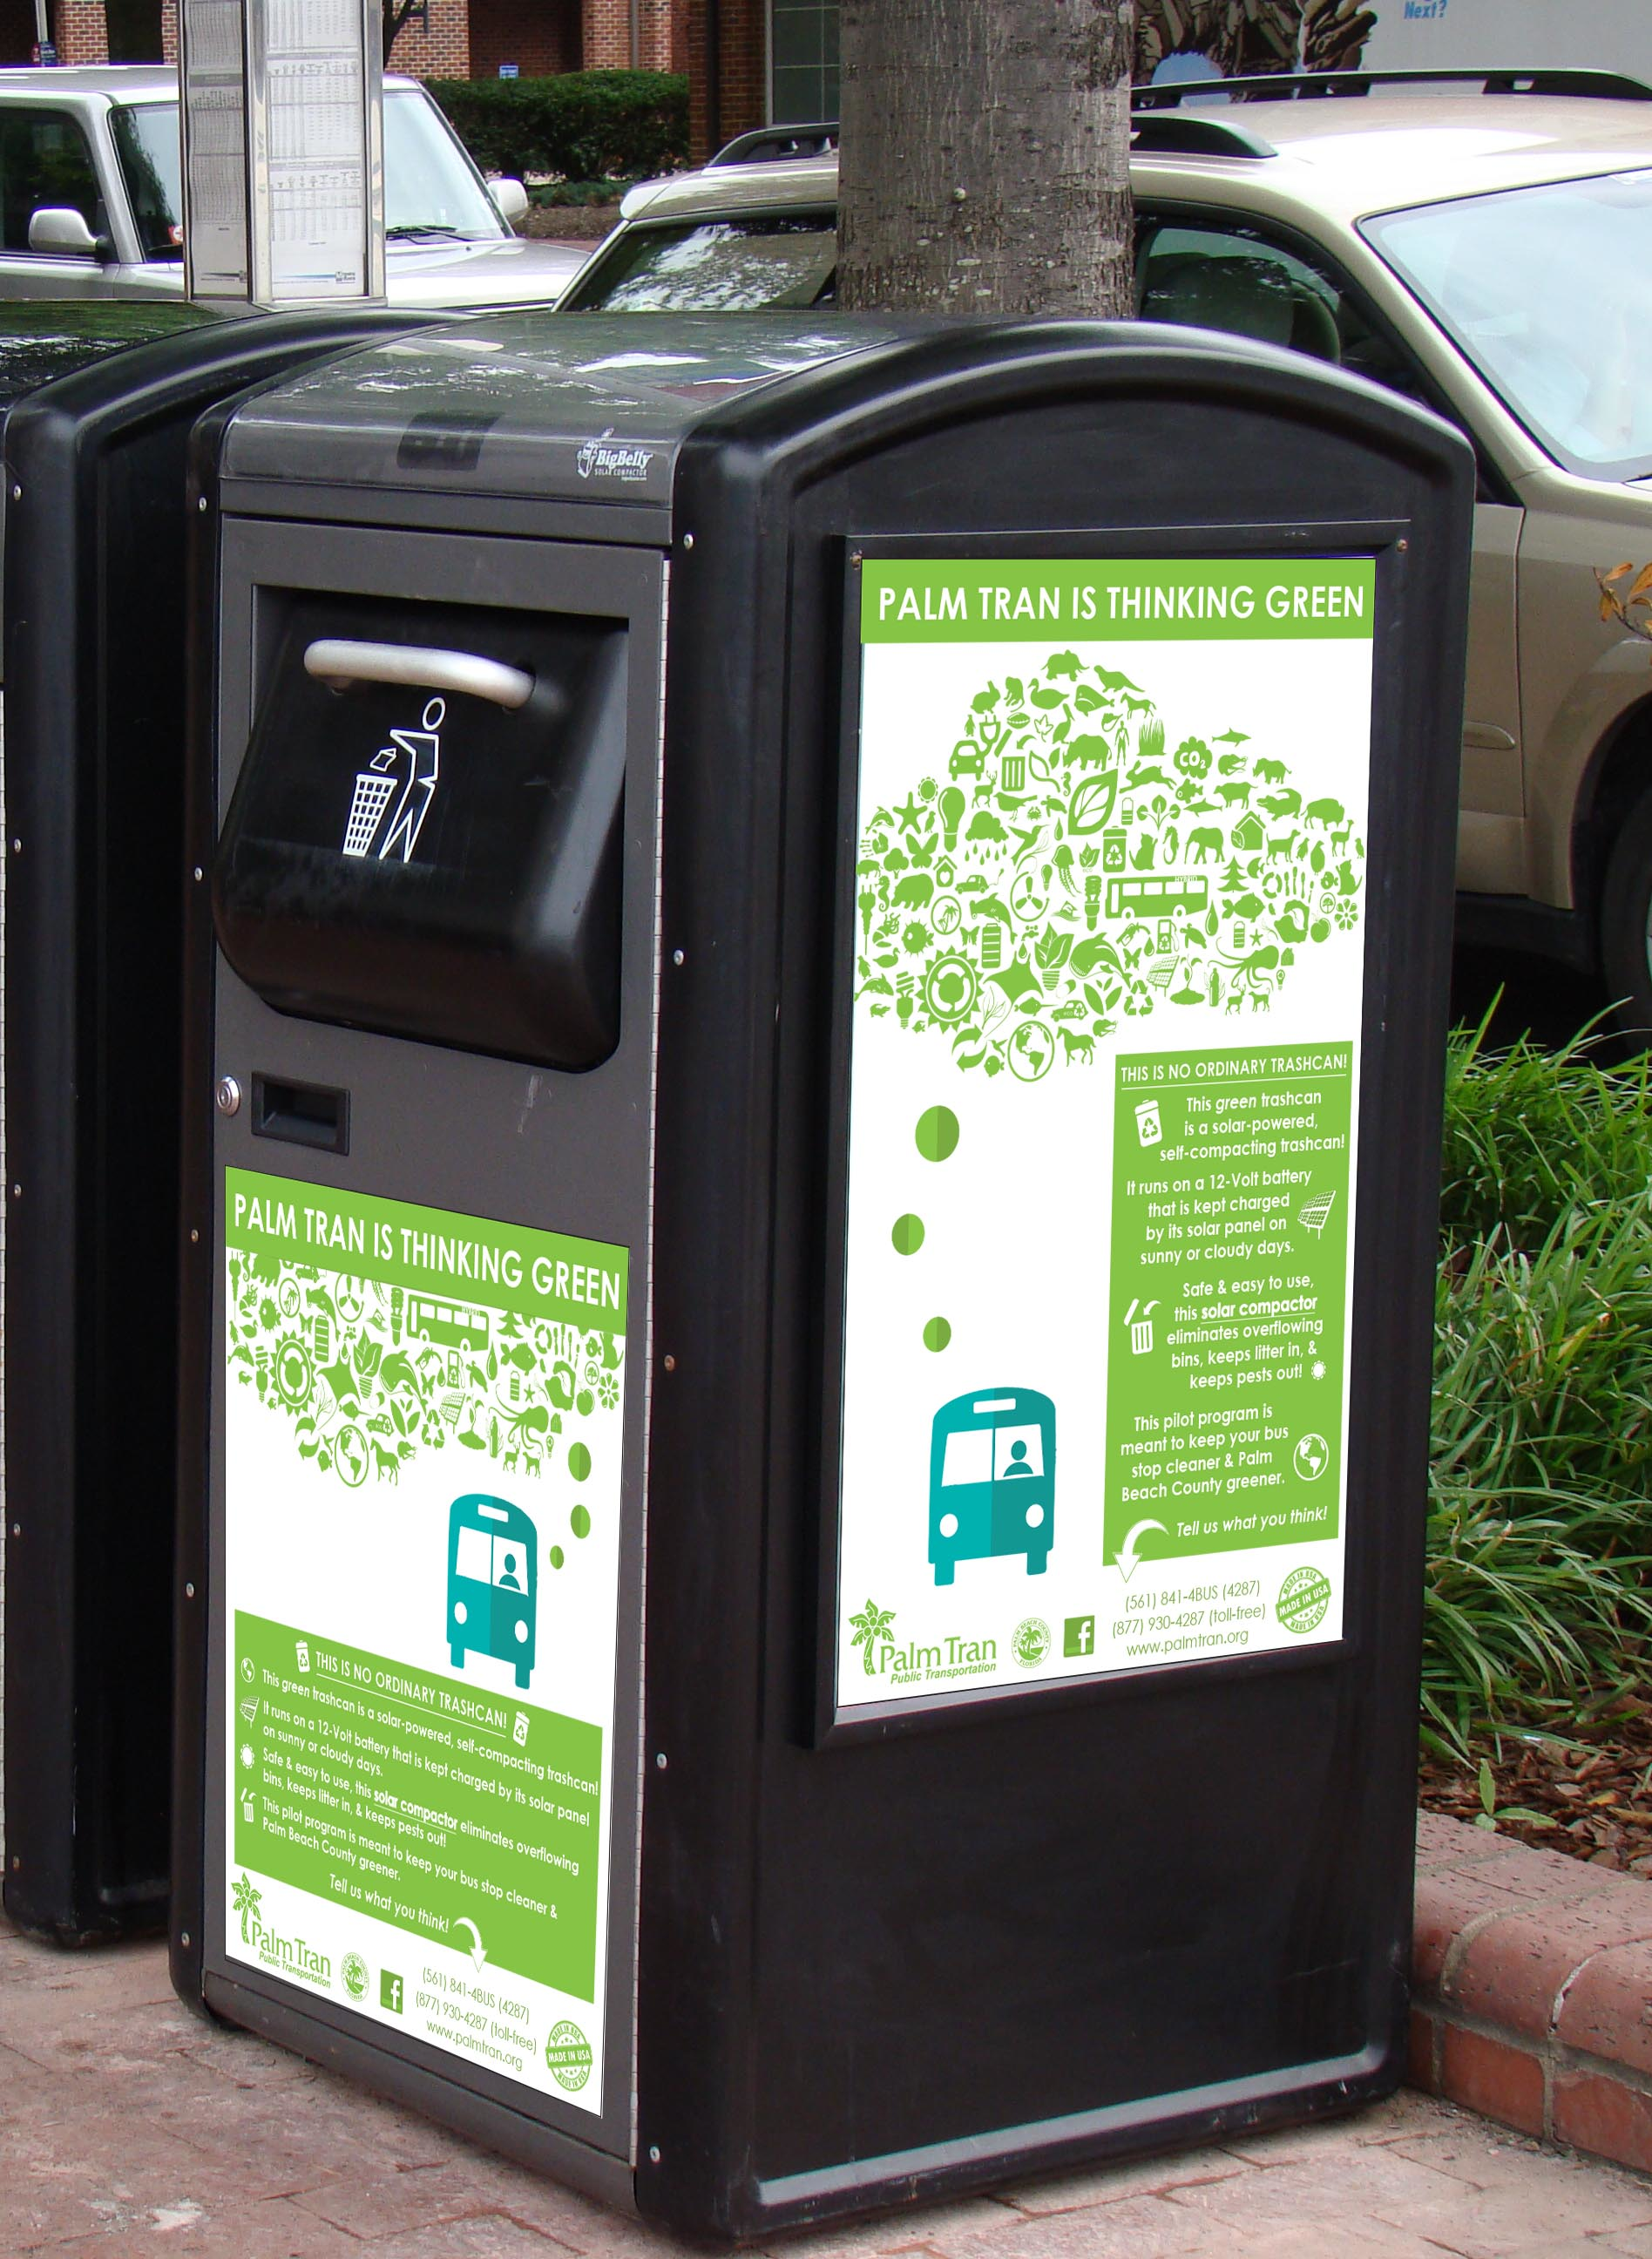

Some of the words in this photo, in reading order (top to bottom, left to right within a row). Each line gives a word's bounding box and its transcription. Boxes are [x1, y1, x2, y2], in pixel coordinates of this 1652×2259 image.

[1403, 0, 1448, 19] Next?
[595, 449, 653, 470] BigBelly
[879, 587, 968, 621] PALM
[978, 587, 1060, 620] TRAN
[1072, 586, 1097, 621] IS
[1106, 585, 1256, 619] THINKING
[1265, 585, 1364, 619] GREEN
[1121, 1066, 1148, 1082] THIS
[1153, 1065, 1164, 1081] IS
[1168, 1062, 1191, 1080] NO
[1195, 1058, 1267, 1078] ORDINARY
[1270, 1054, 1347, 1073] TRASHCAN!
[1186, 1096, 1212, 1112] This
[1215, 1096, 1257, 1115] green
[1261, 1090, 1322, 1108] trashcan
[1184, 1120, 1195, 1136] is
[1198, 1123, 1209, 1136] a
[1212, 1112, 1318, 1136] solar-powered,
[1160, 1139, 1276, 1162] self-compacting
[1280, 1133, 1344, 1153] trashcan!
[1127, 1180, 1136, 1196] It
[1139, 1181, 1168, 1195] runs
[1172, 1179, 1191, 1192] on
[1195, 1178, 1205, 1191] a
[1209, 1171, 1259, 1190] 12-Volt
[1263, 1169, 1312, 1186] battery
[1148, 1201, 1176, 1218] that
[1180, 1199, 1190, 1216] is
[1194, 1197, 1227, 1218] kept
[1229, 1191, 1290, 1213] charged
[1146, 1225, 1165, 1245] by
[1168, 1223, 1183, 1239] its
[1187, 1221, 1221, 1238] solar
[1224, 1217, 1265, 1238] panel
[1269, 1218, 1287, 1231] on
[234, 1192, 297, 1239] PALM
[303, 1207, 365, 1254] TRAN
[374, 1222, 393, 1261] IS
[400, 1227, 523, 1288] THINKING
[531, 1256, 620, 1310] GREEN
[1141, 1250, 1182, 1266] sunny
[1186, 1248, 1201, 1261] or
[1204, 1241, 1254, 1260] cloudy
[1257, 1239, 1294, 1258] days.
[1182, 1281, 1214, 1298] Safe
[1217, 1279, 1227, 1295] &
[1231, 1279, 1265, 1295] easy
[1269, 1275, 1283, 1290] to
[1287, 1275, 1314, 1288] use,
[1174, 1305, 1198, 1322] this
[1201, 1301, 1236, 1323] solar
[1238, 1294, 1318, 1317] compactor
[1167, 1325, 1239, 1346] eliminates
[1242, 1317, 1324, 1338] overflowing
[1171, 1352, 1203, 1368] bins,
[1208, 1349, 1251, 1367] keeps
[1255, 1344, 1284, 1360] litter
[1288, 1341, 1303, 1358] in,
[1308, 1340, 1317, 1355] &
[1189, 1374, 1233, 1390] keeps
[1236, 1367, 1273, 1388] pests
[1276, 1363, 1303, 1380] out!
[1134, 1414, 1160, 1432] This
[1163, 1411, 1195, 1433] pilot
[1198, 1408, 1259, 1429] program
[1263, 1403, 1273, 1419] is
[1121, 1436, 1168, 1456] meant
[1170, 1435, 1185, 1451] to
[1188, 1434, 1226, 1450] keep
[1229, 1429, 1261, 1448] your
[1264, 1426, 1289, 1441] bus
[1132, 1462, 1162, 1480] stop
[1165, 1457, 1221, 1475] cleaner
[1224, 1453, 1234, 1468] &
[1238, 1449, 1273, 1467] Palm
[1121, 1482, 1168, 1502] Beach
[1171, 1477, 1222, 1496] County
[1226, 1473, 1285, 1494] greener.
[1177, 1520, 1200, 1537] Tell
[1203, 1521, 1218, 1534] us
[1222, 1514, 1257, 1531] what
[1260, 1513, 1287, 1531] you
[1290, 1505, 1328, 1524] think!
[1125, 1592, 1156, 1613] (561)
[1160, 1584, 1218, 1606] 841-4BUS
[1222, 1579, 1260, 1602] (4287)
[1279, 1598, 1302, 1618] MADE
[1302, 1592, 1312, 1605] IN
[1312, 1584, 1329, 1599] USA
[1112, 1618, 1144, 1639] (877)
[1148, 1611, 1205, 1632] 930-4287
[1209, 1603, 1266, 1627] (toll-free)
[879, 1640, 942, 1675] Palm
[944, 1635, 997, 1662] Tran
[1126, 1630, 1249, 1657] www.palmtran.org
[890, 1669, 923, 1685] Public
[924, 1661, 997, 1680] Transportation
[1019, 1657, 1042, 1667] FLORIDA
[315, 1651, 338, 1673] THIS
[341, 1659, 350, 1677] IS
[353, 1663, 372, 1684] NO
[375, 1672, 436, 1705] ORDINARY
[438, 1691, 507, 1729] TRASHCAN!
[262, 1668, 280, 1688] This
[281, 1679, 310, 1698] green
[312, 1686, 355, 1713] trashcan
[357, 1701, 365, 1716] is
[367, 1708, 375, 1720] a
[376, 1711, 454, 1749] solar-powered,
[457, 1738, 545, 1781] self-compacting
[546, 1765, 599, 1796] trashcan!
[262, 1816, 287, 1838] Palm
[288, 1826, 320, 1850] Beach
[322, 1839, 357, 1867] County
[359, 1856, 401, 1881] greener.
[262, 1796, 280, 1815] This
[281, 1806, 303, 1824] pilot
[304, 1815, 347, 1840] program
[349, 1828, 356, 1844] is
[358, 1835, 391, 1856] meant
[393, 1845, 403, 1861] to
[405, 1849, 432, 1874] keep
[435, 1864, 458, 1881] your
[460, 1869, 478, 1889] bus
[481, 1879, 504, 1900] stop
[506, 1889, 548, 1915] cleaner
[550, 1904, 558, 1919] &
[251, 1920, 294, 1962] Palm
[294, 1937, 331, 1977] Tran
[259, 1950, 281, 1968] Public
[281, 1959, 331, 1989] Transportation
[423, 1966, 447, 1992] (561)
[450, 1977, 496, 2009] 841-4BUS
[498, 1997, 530, 2025] (4287)
[416, 1991, 440, 2016] (877)
[443, 2001, 488, 2032] 930-4287
[491, 2021, 537, 2056] (toll-free)
[426, 2020, 523, 2072] www.palmtran.org
[548, 2051, 567, 2064] MADE
[567, 2050, 576, 2061] IN
[577, 2049, 592, 2061] USA
